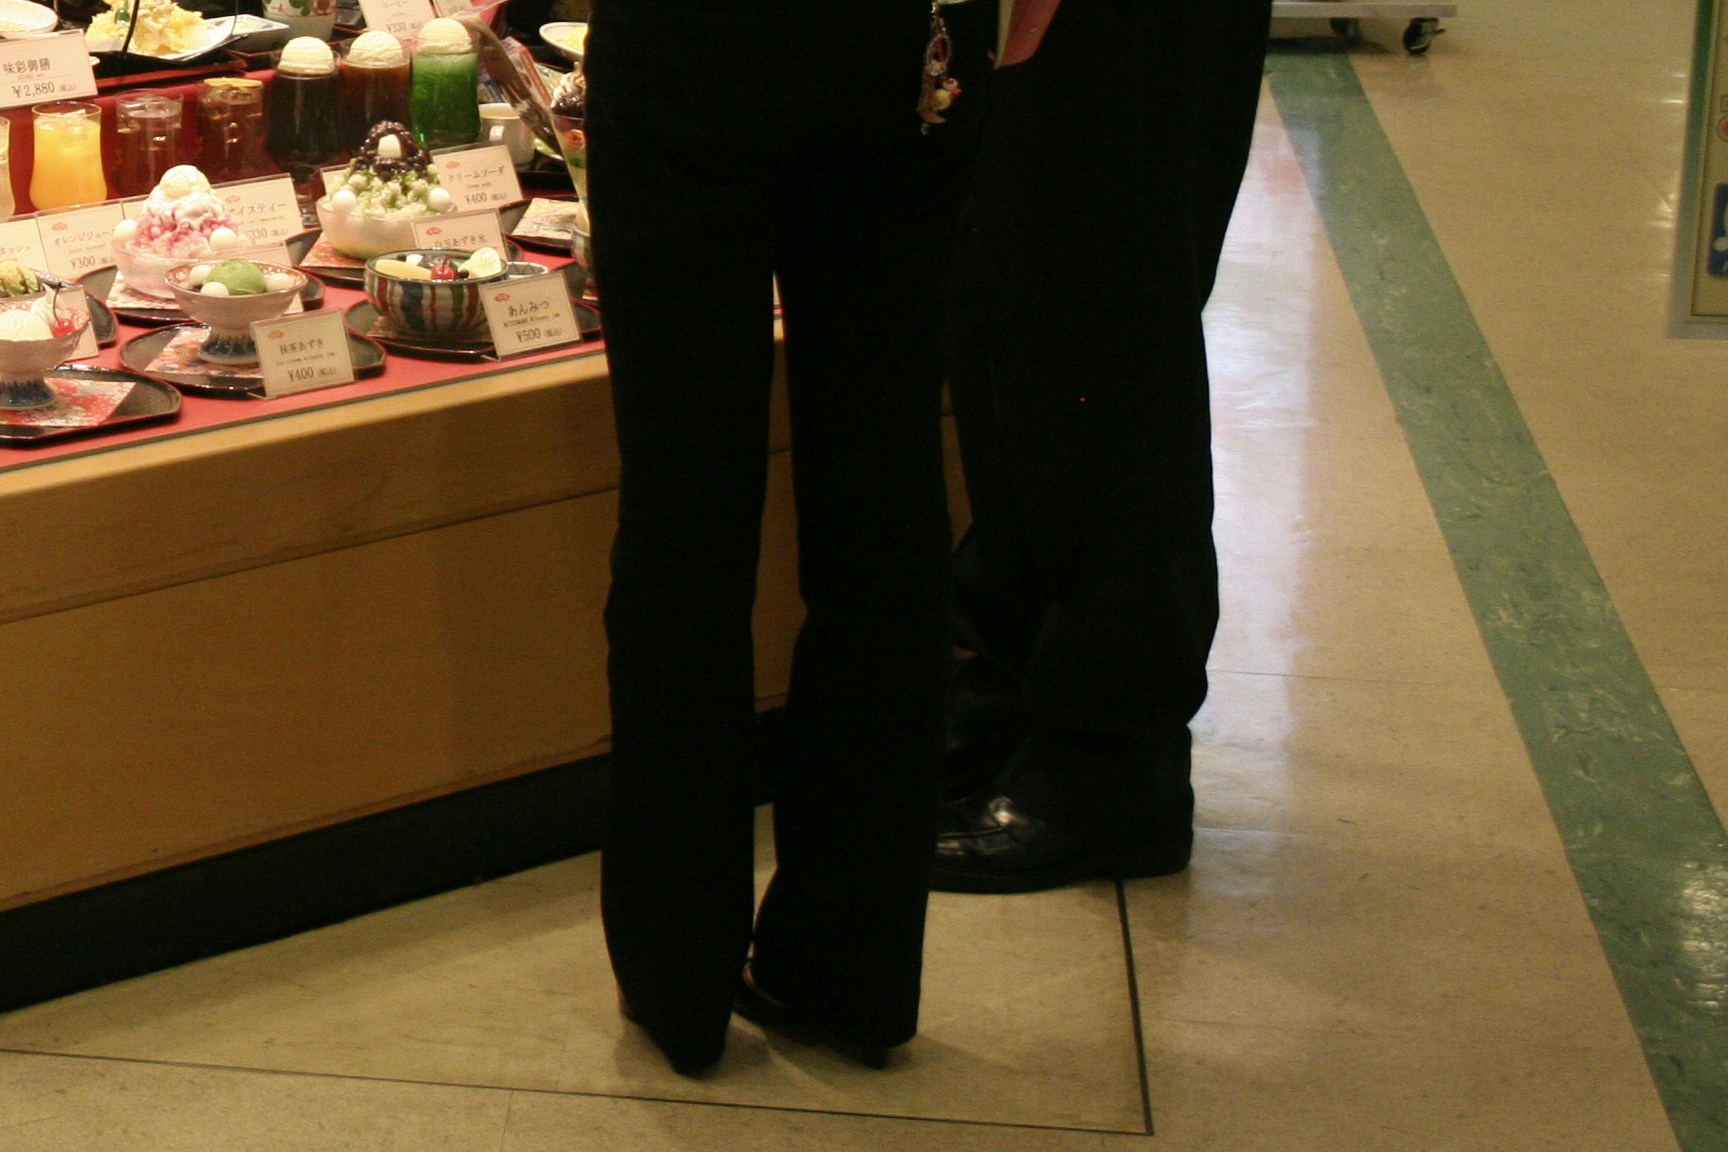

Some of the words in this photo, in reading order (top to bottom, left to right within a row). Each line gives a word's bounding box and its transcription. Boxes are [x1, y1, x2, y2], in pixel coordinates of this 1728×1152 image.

[11, 82, 55, 98] ¥2,880
[464, 192, 488, 206] ¥400
[70, 255, 96, 270] ¥300
[507, 301, 550, 318] あんみつ
[515, 327, 542, 343] ¥500
[286, 366, 315, 382] ¥400
